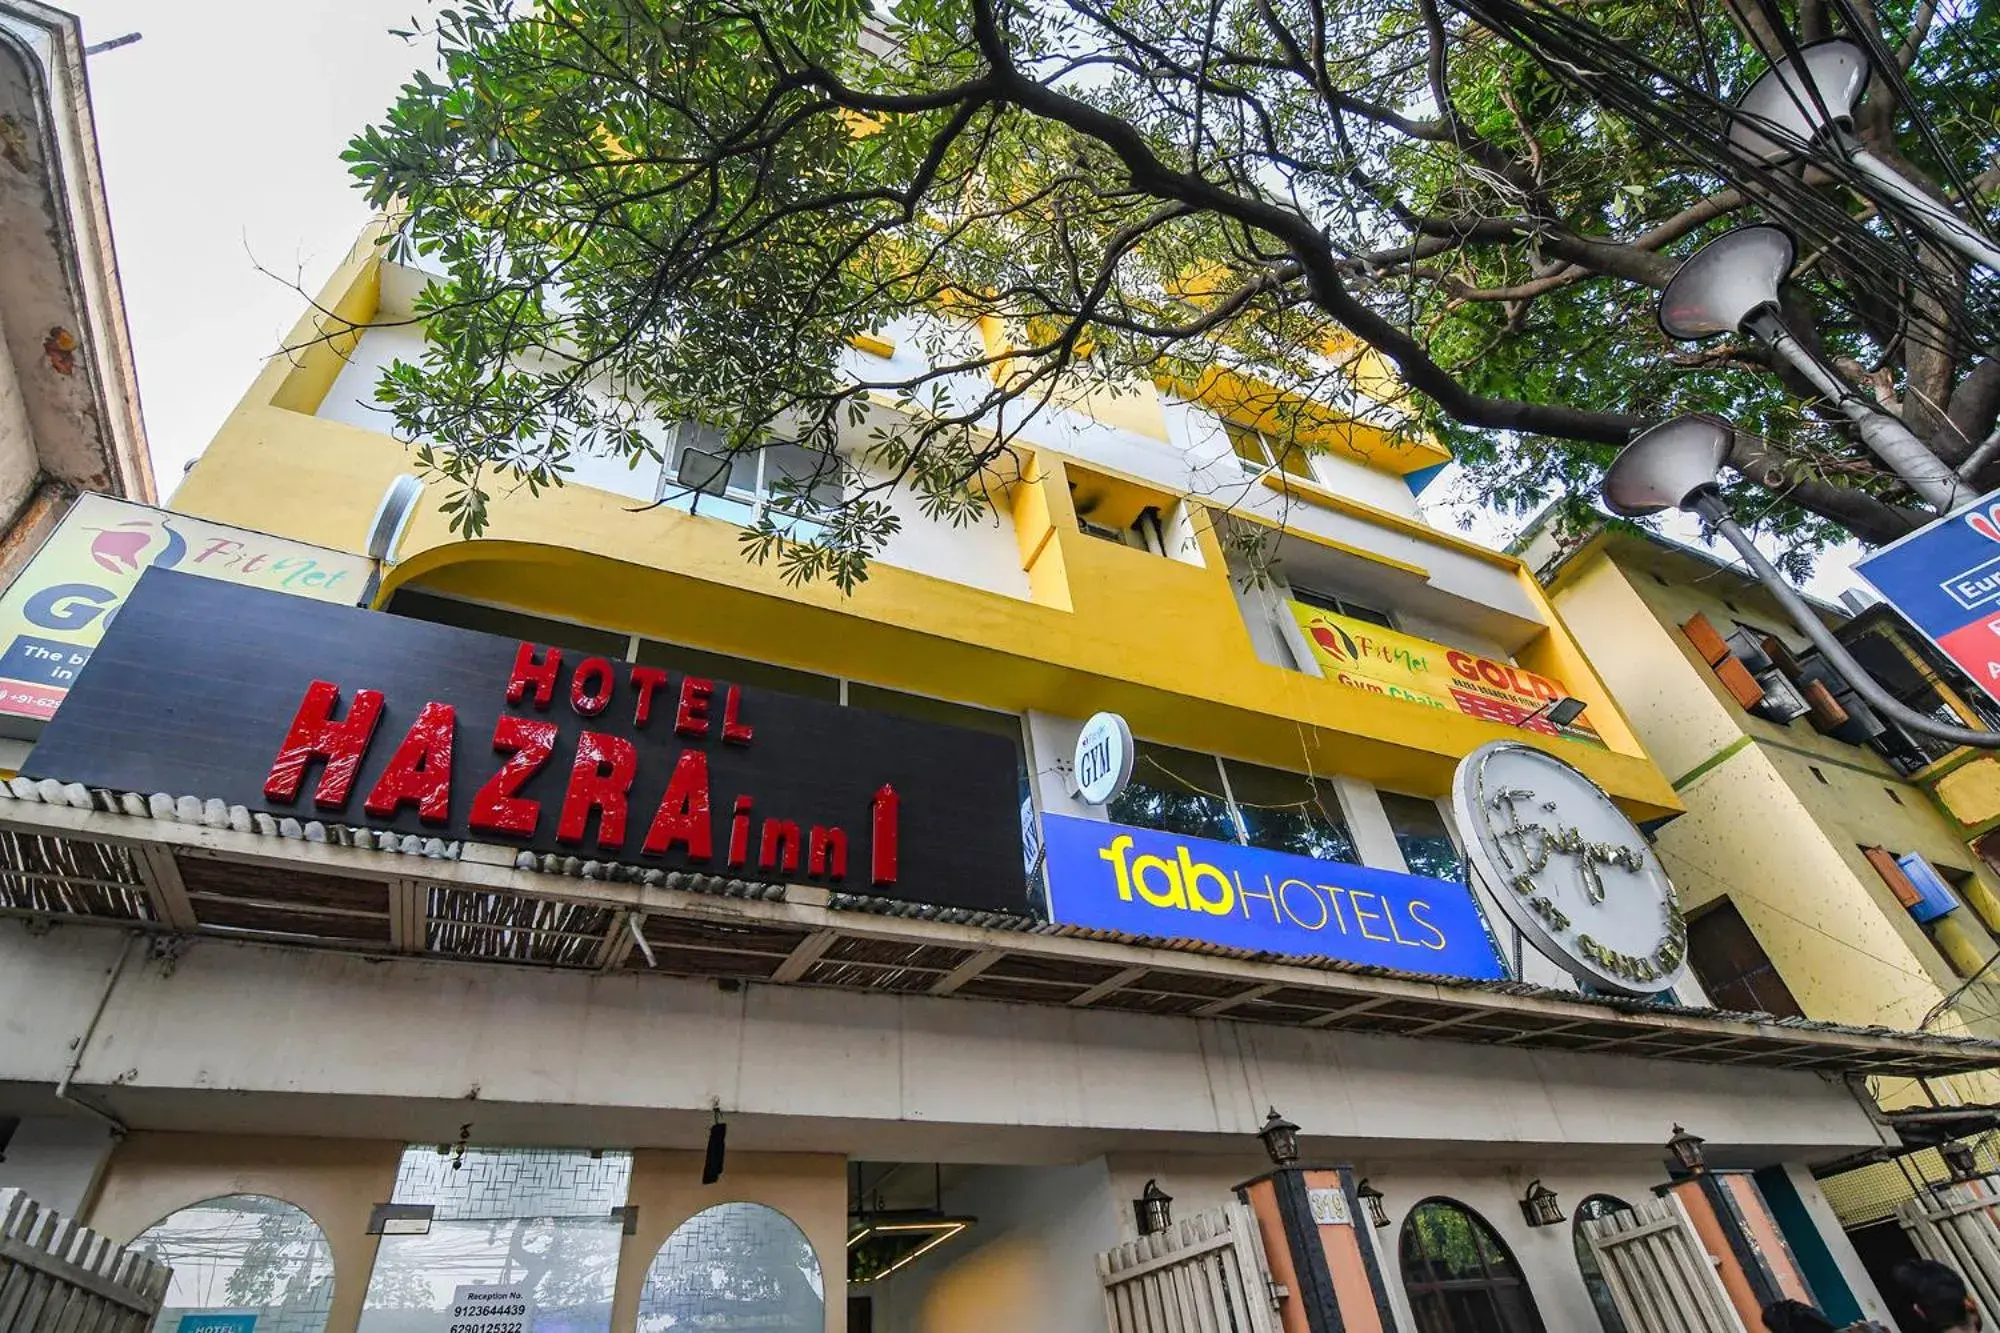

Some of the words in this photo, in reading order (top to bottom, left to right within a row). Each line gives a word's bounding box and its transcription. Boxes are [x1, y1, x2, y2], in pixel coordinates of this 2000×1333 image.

[24, 645, 63, 662] The
[51, 666, 73, 680] in
[1446, 651, 1558, 701] GOLD
[505, 641, 754, 744] HOTEL
[1081, 736, 1111, 788] GYM
[264, 679, 712, 863] HAZRA
[728, 794, 848, 879] inn
[454, 1304, 526, 1317] 9123644439
[467, 1292, 507, 1301] Reception
[508, 1292, 523, 1300] No.
